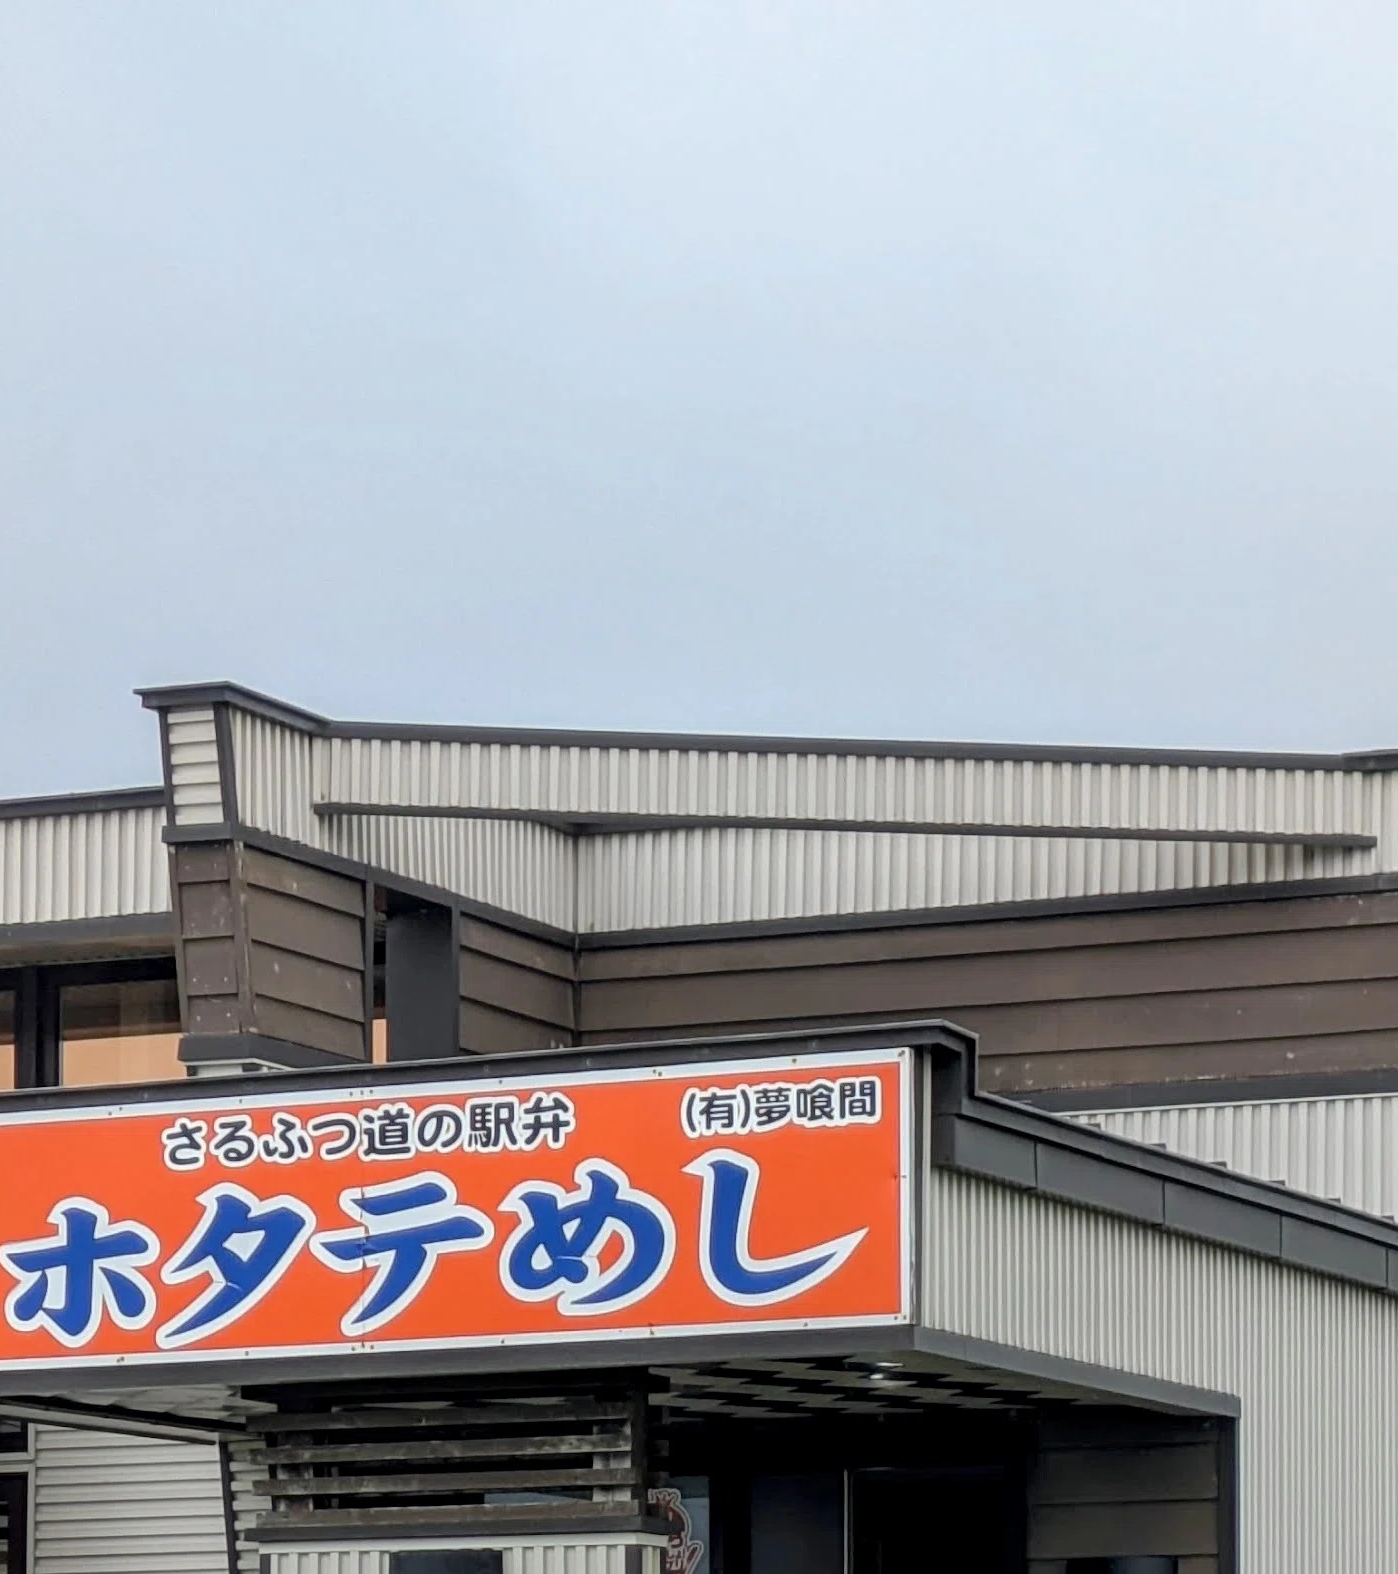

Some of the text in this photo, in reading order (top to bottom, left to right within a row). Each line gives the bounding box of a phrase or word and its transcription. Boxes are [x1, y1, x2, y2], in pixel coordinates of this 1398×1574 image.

[166, 1096, 571, 1165] さるふつ道の駅弁
[686, 1080, 876, 1132] (有)夢喰間
[1, 1155, 869, 1345] ホタテめし
